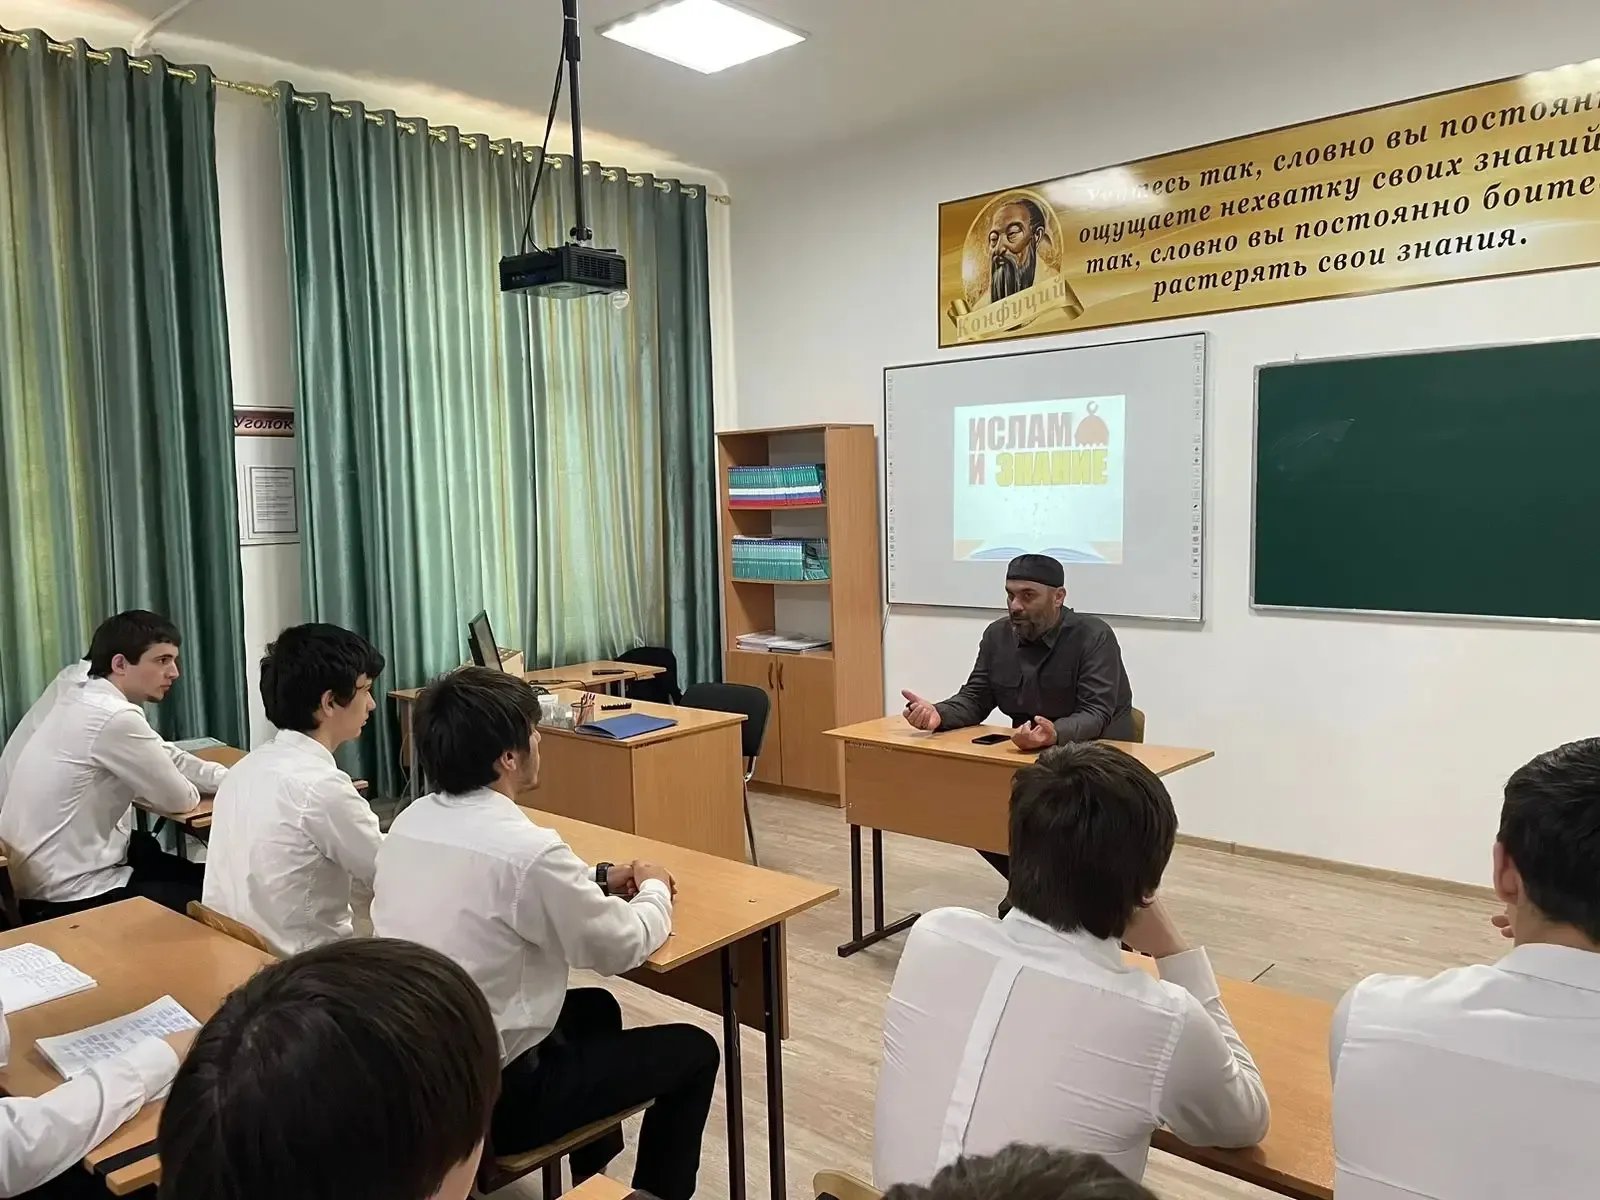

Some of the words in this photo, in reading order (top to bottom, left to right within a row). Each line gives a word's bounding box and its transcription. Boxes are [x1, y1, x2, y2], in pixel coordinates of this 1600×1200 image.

[1200, 161, 1262, 187] так,
[1273, 136, 1375, 172] словно
[1386, 125, 1428, 149] вы
[1440, 91, 1600, 139] постоян
[1079, 204, 1211, 245] ощущаете
[1220, 176, 1361, 218] нехватку
[1372, 156, 1462, 190] своих
[1086, 252, 1141, 275] так,
[1150, 235, 1238, 264] словно
[1248, 226, 1284, 248] вы
[1295, 195, 1470, 241] постоянно
[1483, 175, 1600, 210] боите
[1152, 260, 1307, 303] растерять
[1318, 247, 1385, 273] свои
[1396, 227, 1527, 262] знания.
[957, 278, 1065, 338] Конфуций
[233, 415, 293, 430] Уголок
[968, 412, 1072, 451] ИСЛАМ
[968, 451, 985, 486] И
[995, 448, 1109, 487] ЗНАНИЕ
